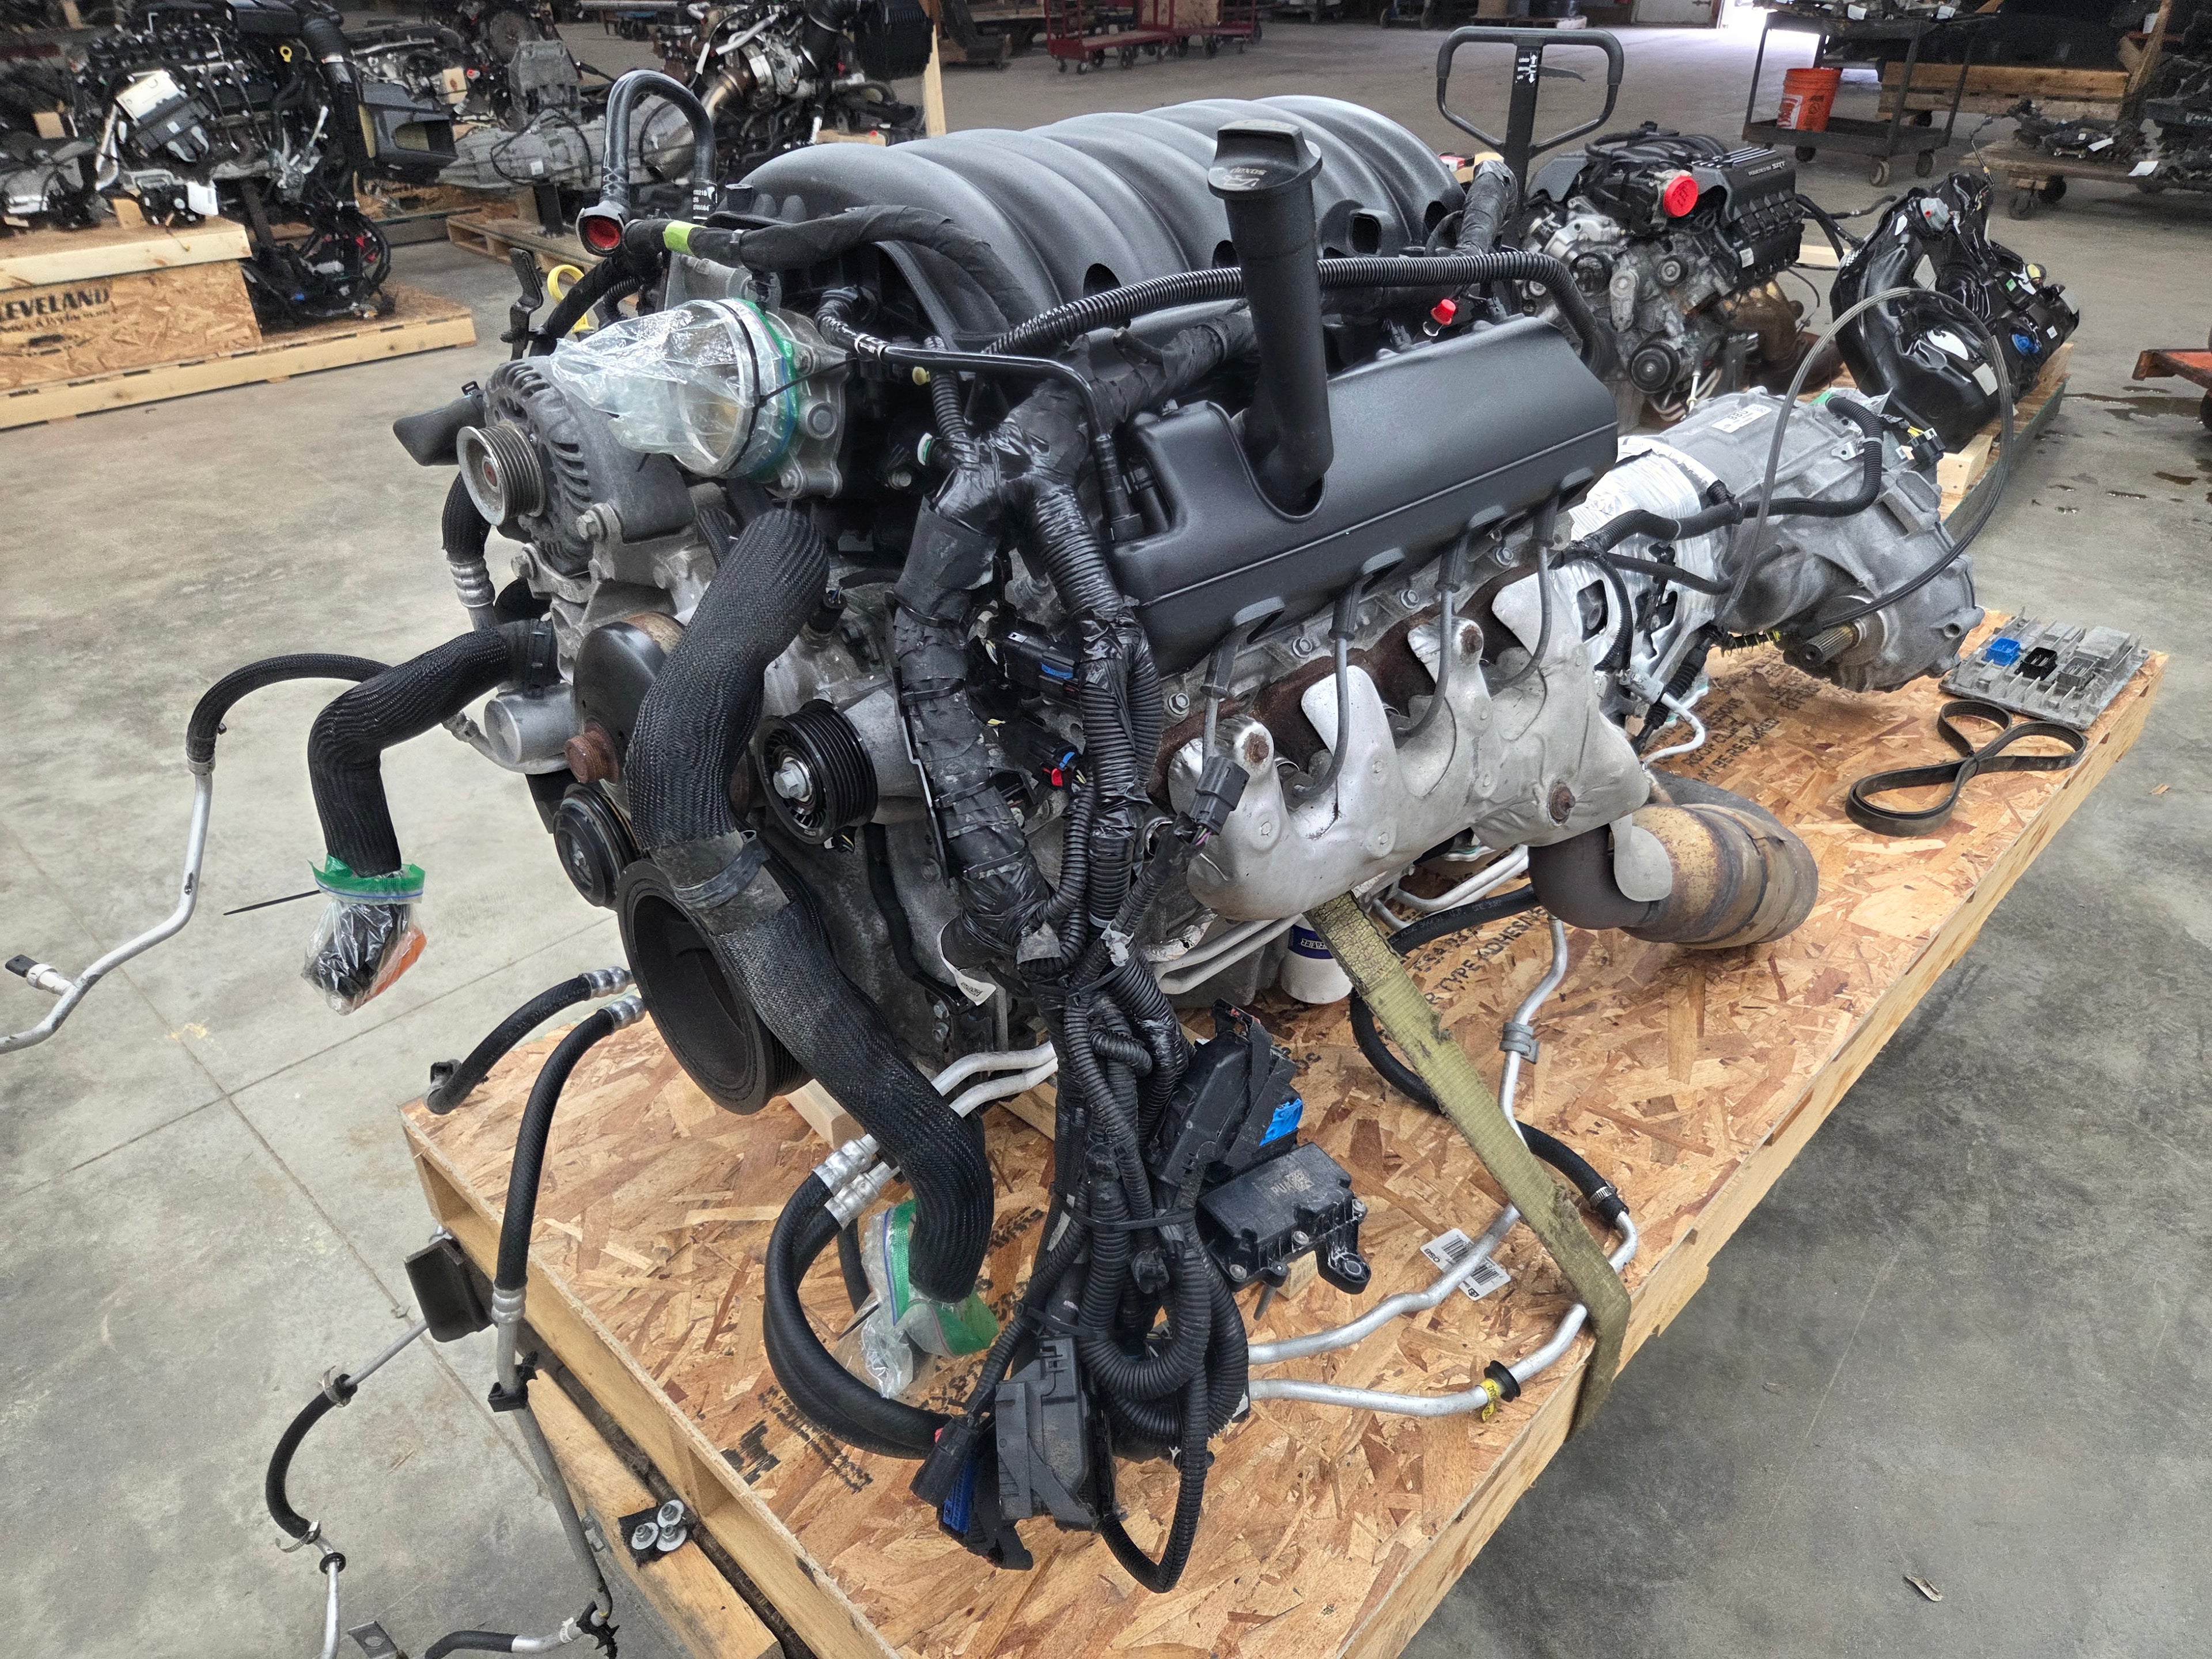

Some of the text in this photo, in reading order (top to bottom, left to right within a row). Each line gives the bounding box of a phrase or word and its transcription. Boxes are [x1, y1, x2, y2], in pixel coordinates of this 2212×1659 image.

[1230, 166, 1267, 175] dexos
[1434, 959, 1482, 992] TYPE
[1424, 1248, 1440, 1263] OSB
